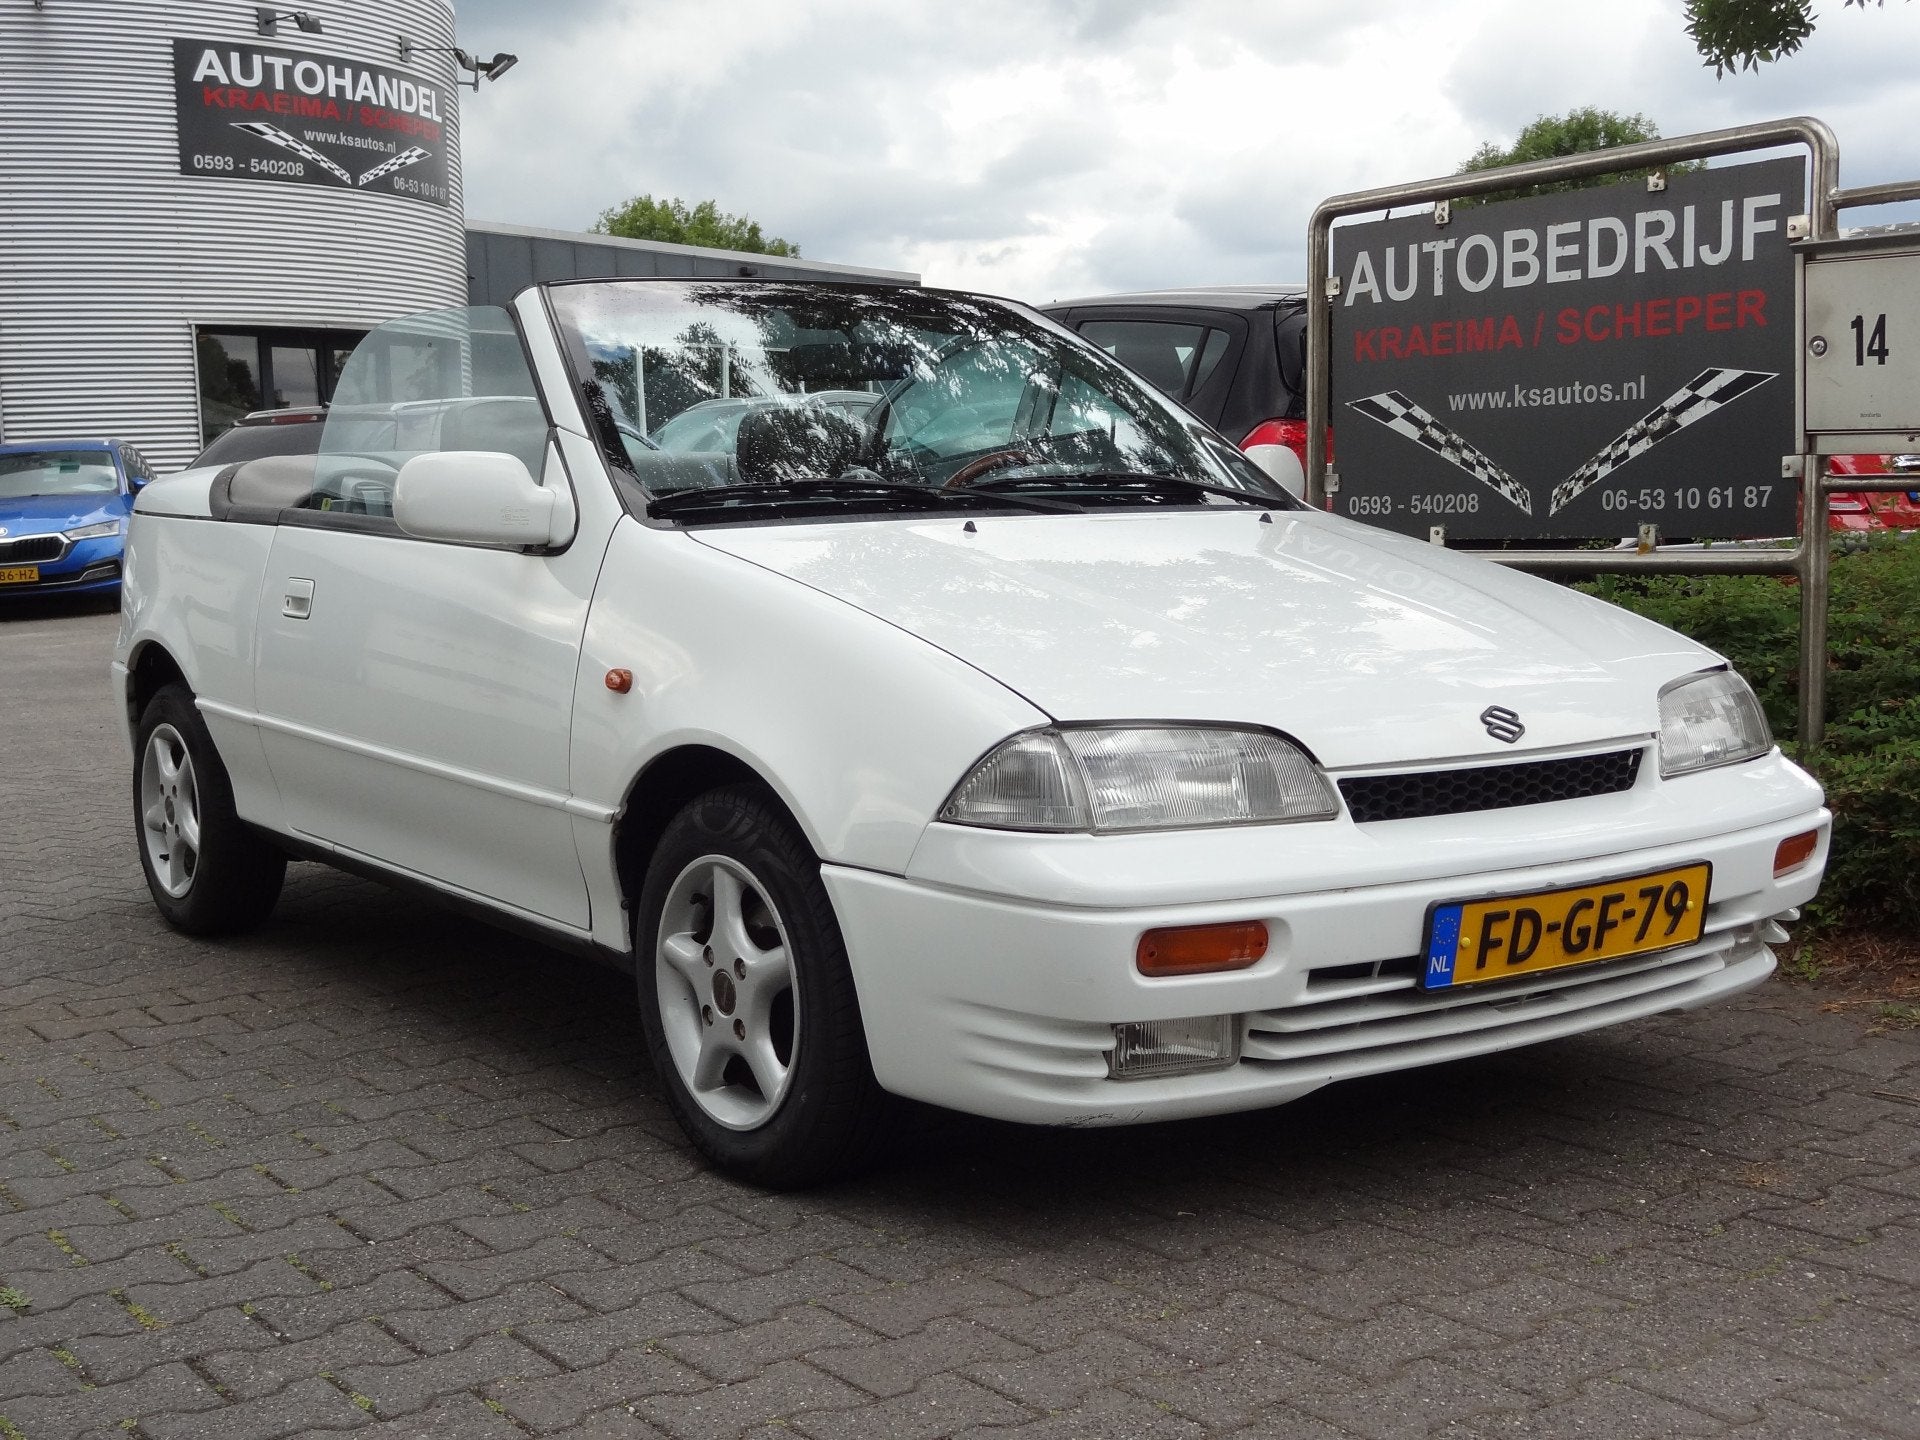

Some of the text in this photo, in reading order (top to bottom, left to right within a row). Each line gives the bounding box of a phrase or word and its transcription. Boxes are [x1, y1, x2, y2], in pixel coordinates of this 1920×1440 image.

[193, 49, 442, 123] AUTOHANDEL
[203, 85, 440, 142] KRAEIMA / SCHEPER
[304, 130, 396, 154] www.ksautos.nl
[193, 154, 234, 171] 0593
[250, 158, 304, 176] 540208
[394, 176, 419, 193] 06-53
[421, 182, 430, 196] 10
[431, 184, 438, 198] 61
[1344, 193, 1781, 307] AUTOBEDRIJF
[1354, 289, 1768, 363] KRAEIMA / SCHEPER
[1851, 313, 1889, 367] 14
[1449, 375, 1646, 411] www.ksautos.nl
[1349, 496, 1392, 516] 0593
[1410, 493, 1479, 515] 540208
[1601, 485, 1773, 511] 06-53 10 61 87
[1475, 880, 1690, 970] FD-GF-79
[1429, 956, 1450, 975] NL
